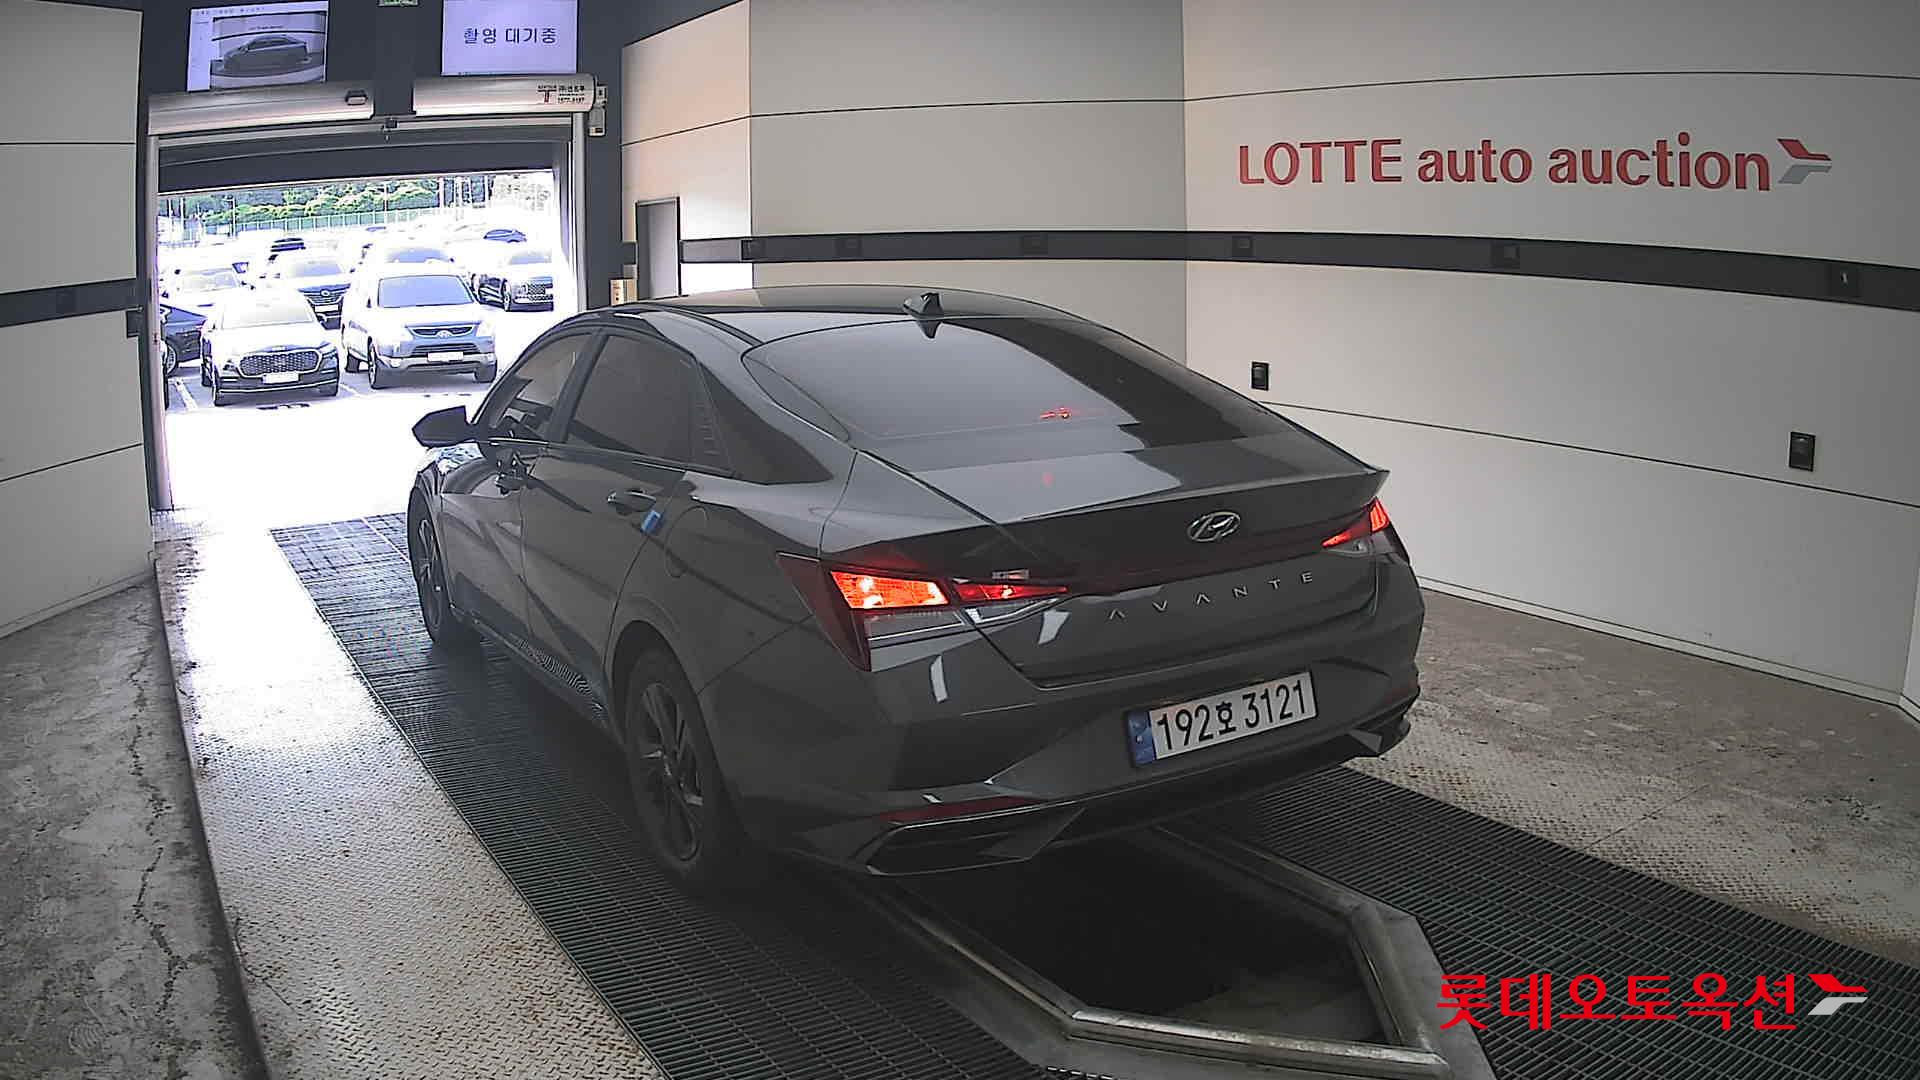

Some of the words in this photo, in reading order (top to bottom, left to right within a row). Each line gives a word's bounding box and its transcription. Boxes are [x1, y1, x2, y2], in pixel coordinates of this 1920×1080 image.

[464, 28, 497, 44] 촬영
[505, 27, 556, 44] 대기중
[1239, 138, 1402, 186] LOTTE
[1417, 139, 1533, 185] auto
[1548, 131, 1771, 192] auction
[1107, 571, 1314, 621] AVANTE
[1242, 680, 1305, 729] 3121
